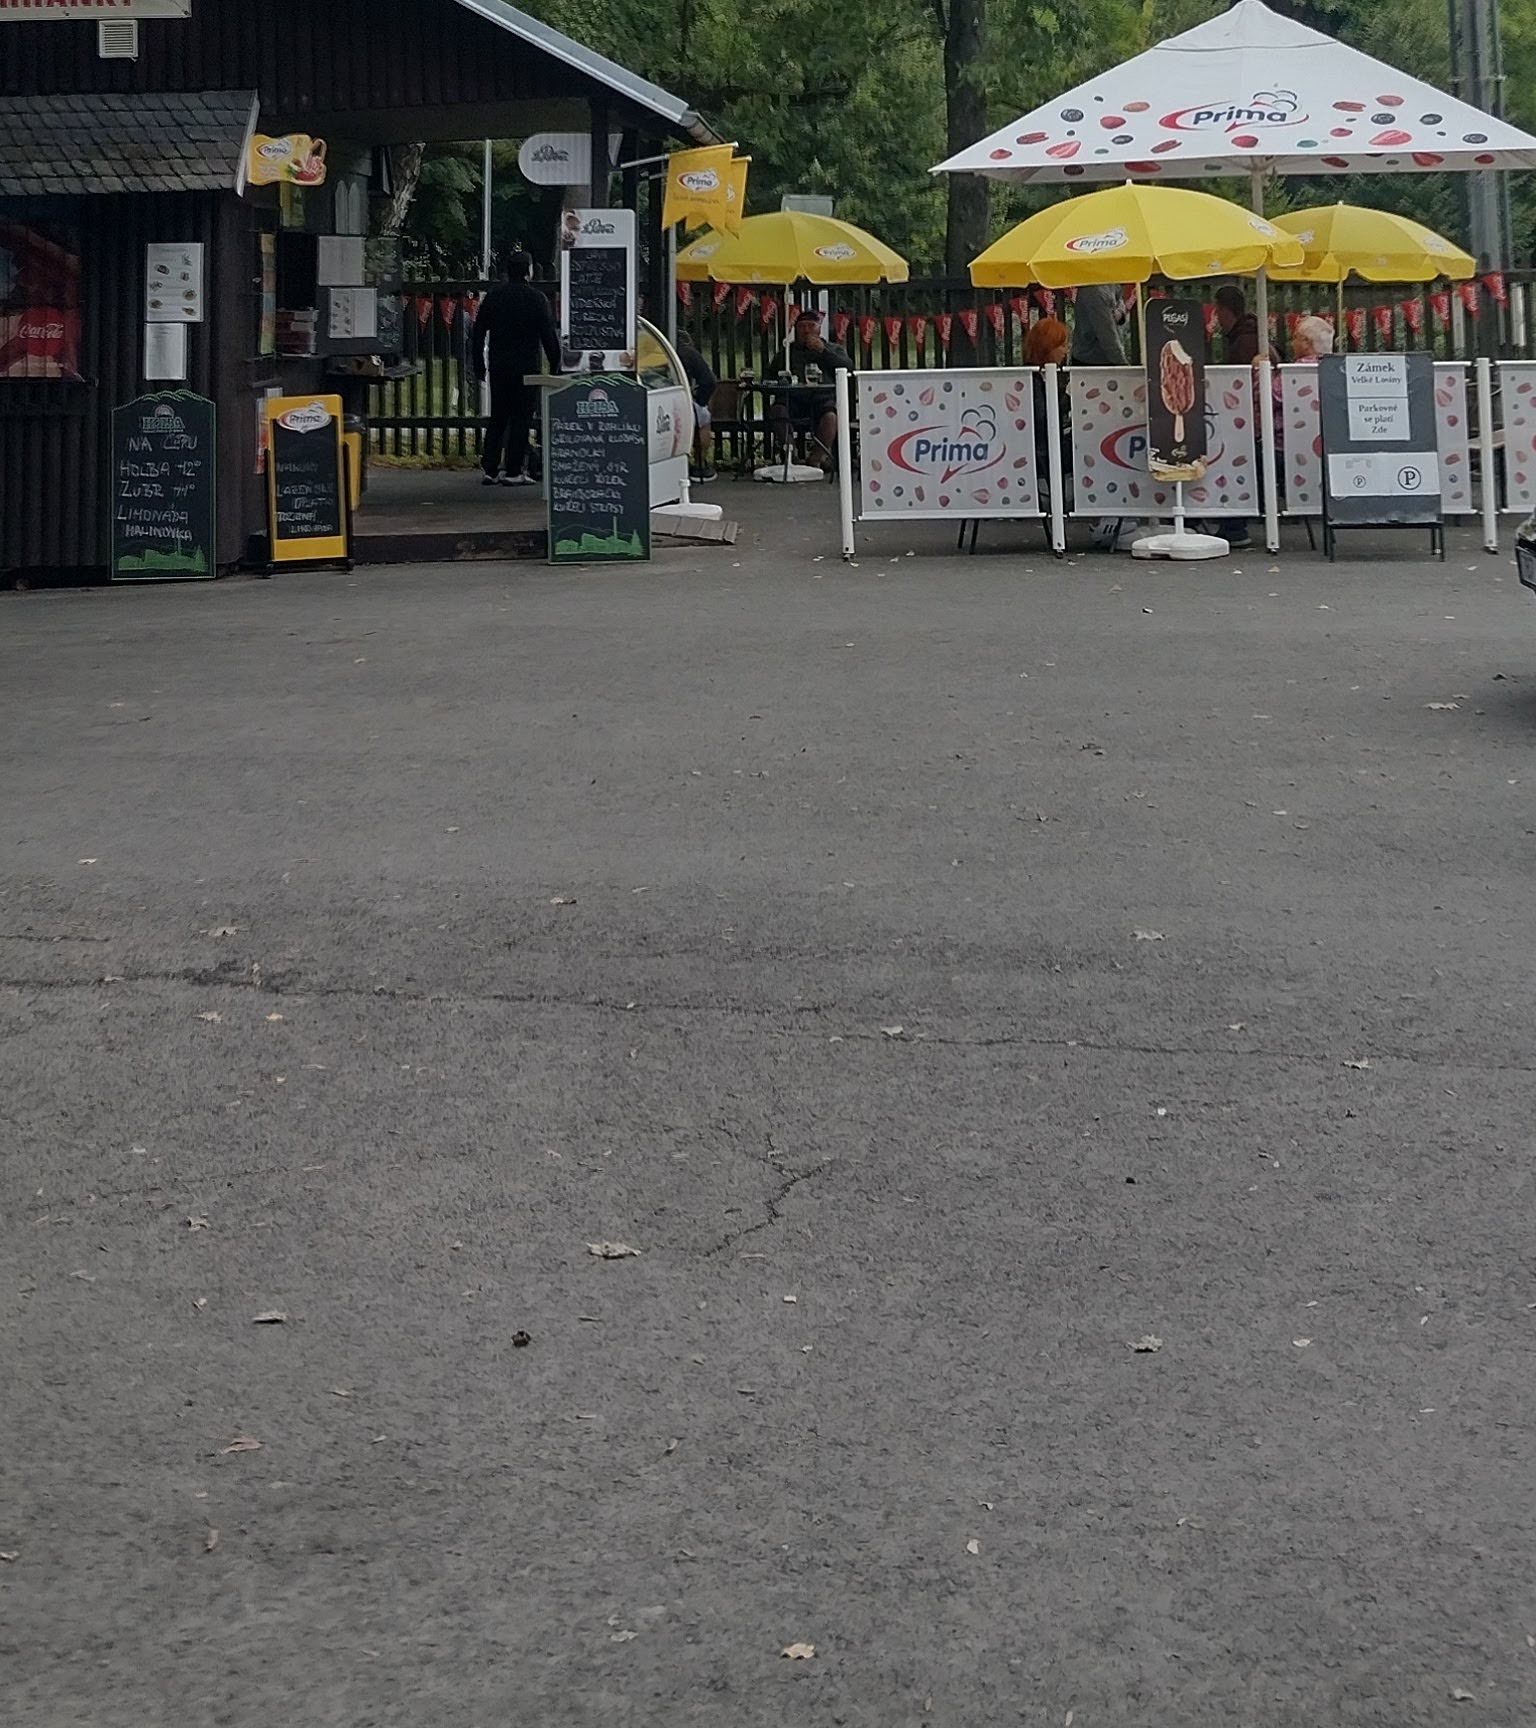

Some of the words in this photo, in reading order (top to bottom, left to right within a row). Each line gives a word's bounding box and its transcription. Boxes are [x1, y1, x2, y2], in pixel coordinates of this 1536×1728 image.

[1193, 106, 1287, 124] Prima
[687, 176, 712, 187] Prima
[1079, 237, 1118, 249] Prima
[1357, 362, 1395, 372] Zámek
[1351, 376, 1373, 384] Velké
[1375, 376, 1401, 385] Losiny
[1358, 403, 1398, 413] Parkovné
[1375, 415, 1393, 425] platí
[1371, 426, 1387, 434] Zde
[128, 436, 152, 451] NA
[914, 437, 989, 463] Prima
[120, 460, 170, 477] HOLBA
[117, 503, 189, 524] LIMONÁDA
